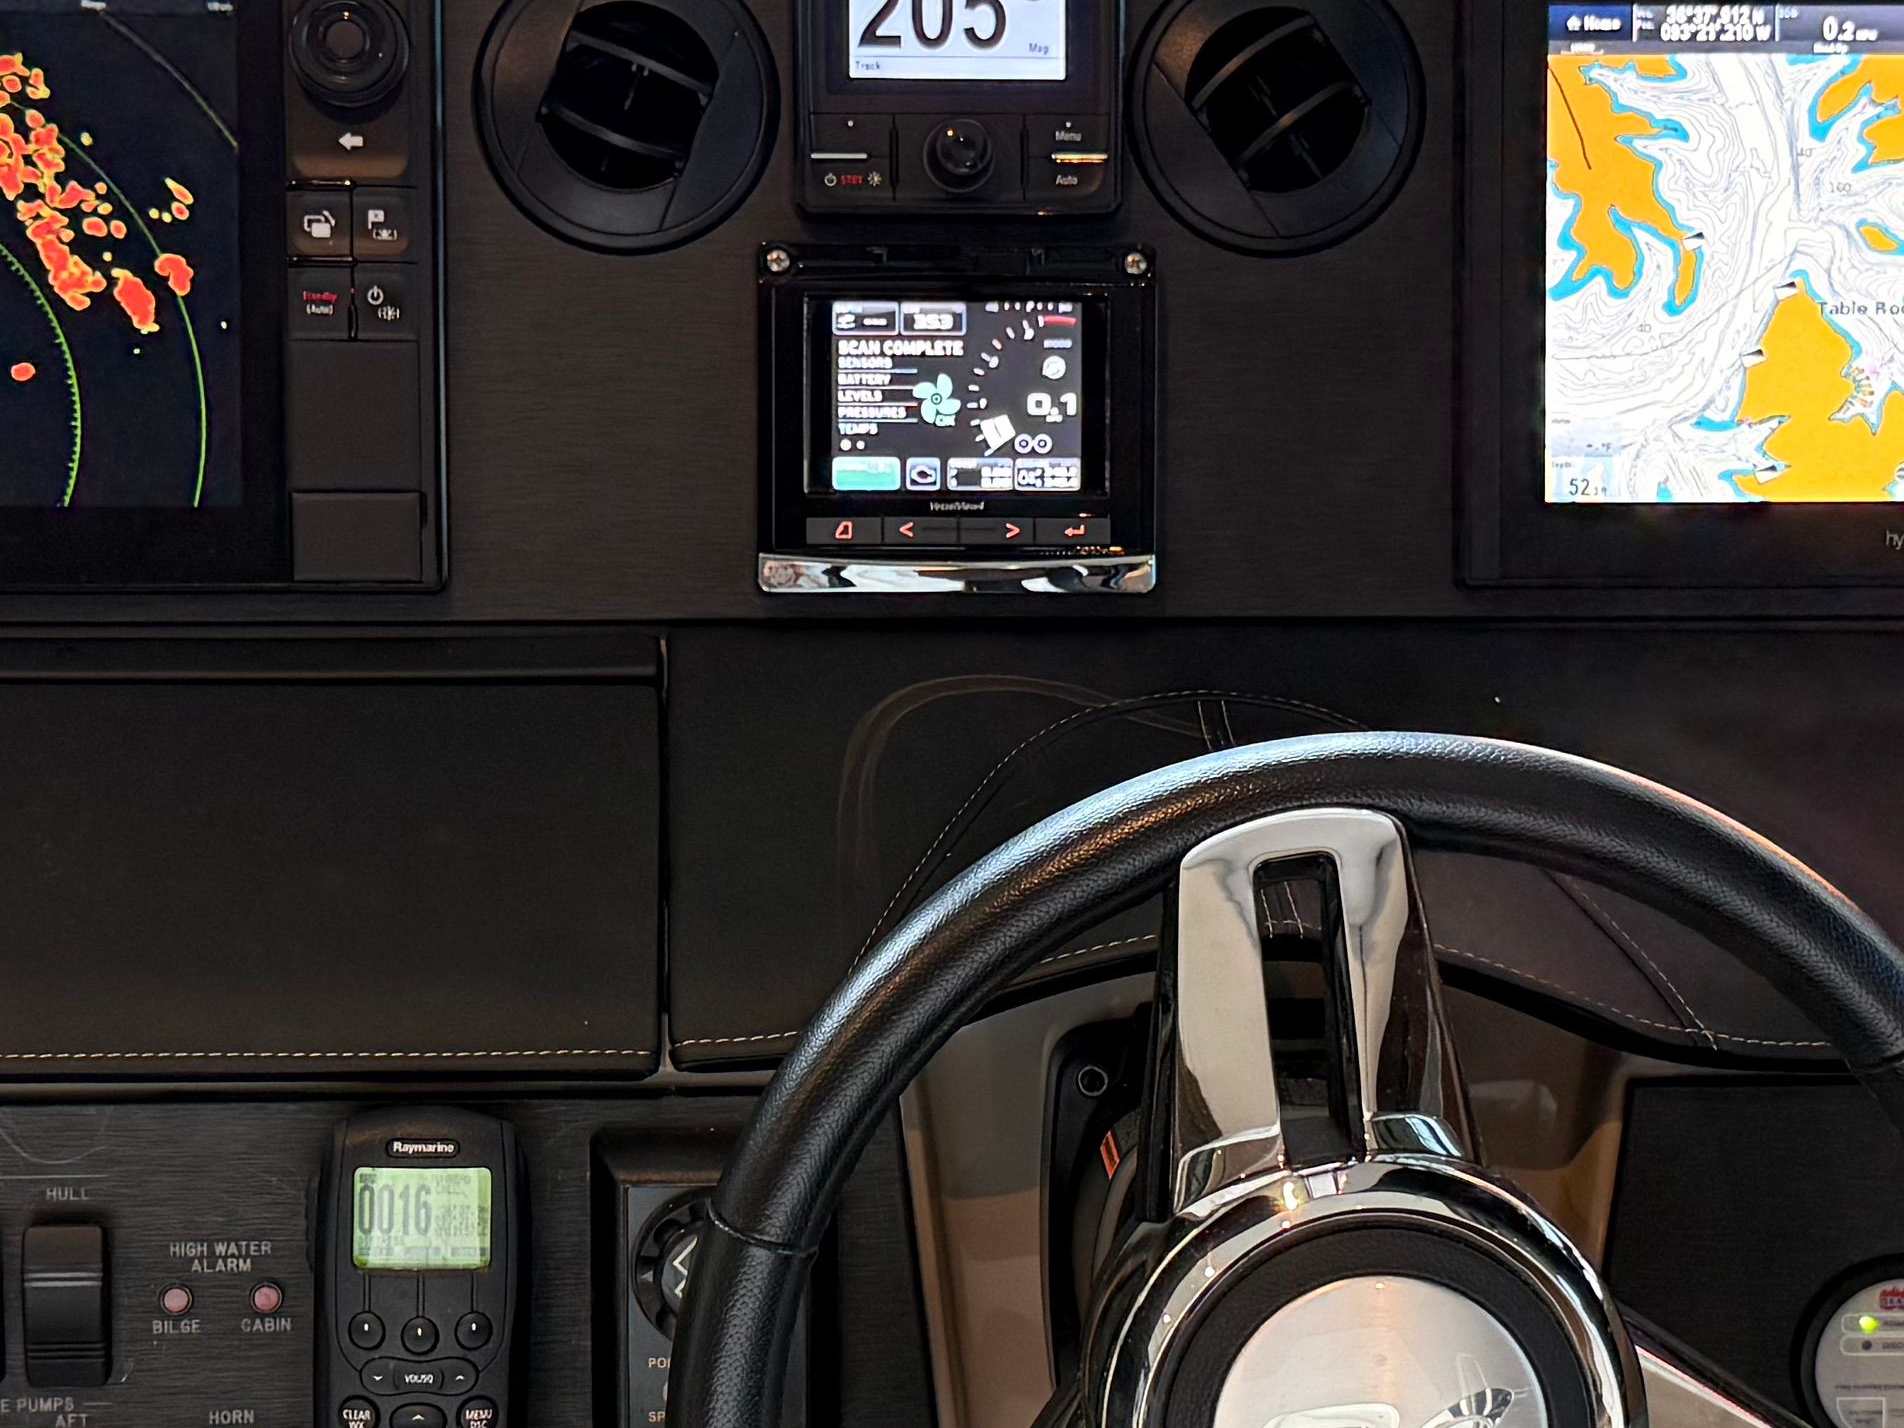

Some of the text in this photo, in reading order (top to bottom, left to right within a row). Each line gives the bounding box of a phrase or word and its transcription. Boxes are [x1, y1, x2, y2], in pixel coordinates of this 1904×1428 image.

[1029, 43, 1049, 55] Mag
[1055, 130, 1082, 142] Menu
[1055, 174, 1078, 185] Auto
[1819, 302, 1868, 316] Table
[837, 340, 964, 356] SCAN COMPLETE
[393, 1141, 455, 1154] Raymarine
[46, 1187, 89, 1201] HULL
[170, 1241, 272, 1257] HIGH WATER
[191, 1258, 252, 1273] ALARM
[153, 1320, 202, 1334] BILGE
[241, 1318, 291, 1332] CABIN
[17, 1396, 75, 1413] PUMPS
[55, 1413, 87, 1428] AFT
[209, 1409, 254, 1426] HORN
[343, 1409, 371, 1421] CLEAR
[465, 1409, 492, 1421] MENU
